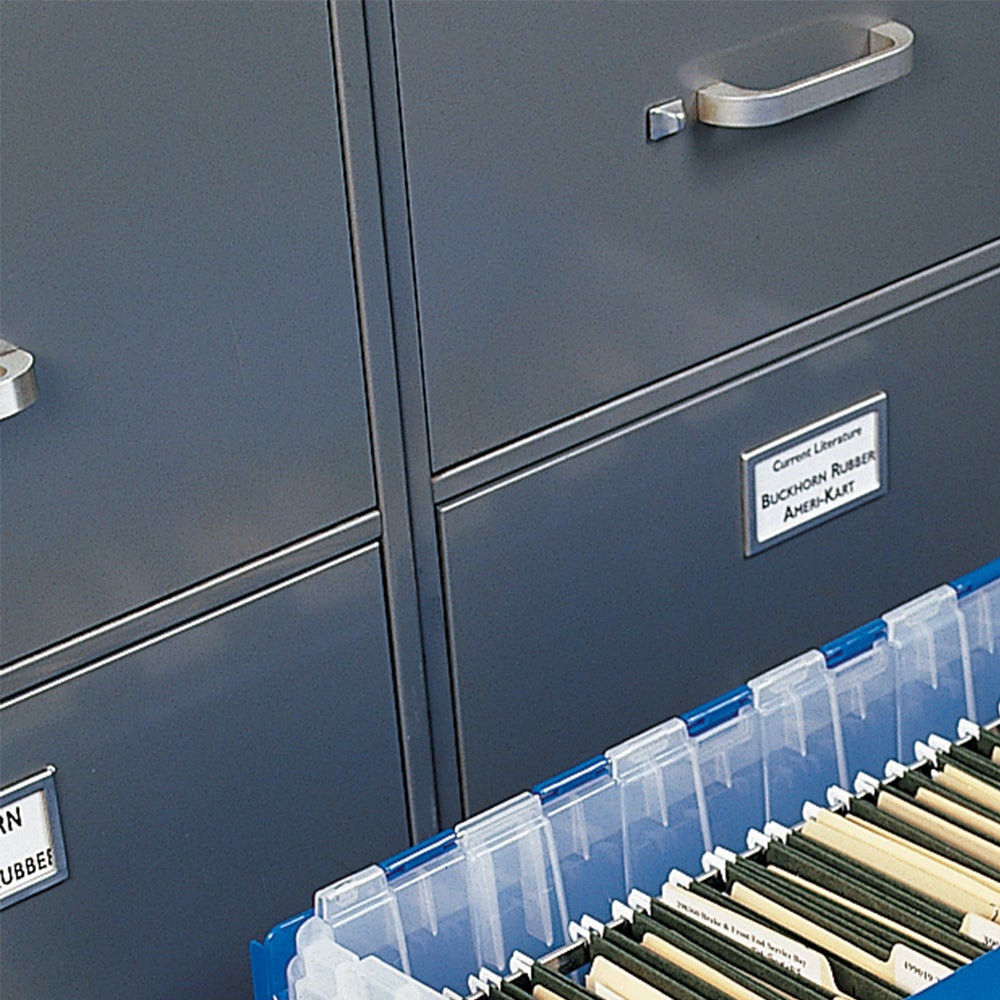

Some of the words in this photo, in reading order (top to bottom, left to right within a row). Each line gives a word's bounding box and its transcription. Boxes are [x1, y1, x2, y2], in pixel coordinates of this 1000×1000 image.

[772, 448, 812, 472] Current
[814, 427, 862, 454] Literature
[761, 470, 827, 509] BUCKHORN
[831, 450, 876, 478] RUBBER
[783, 480, 855, 522] AMERI-KART
